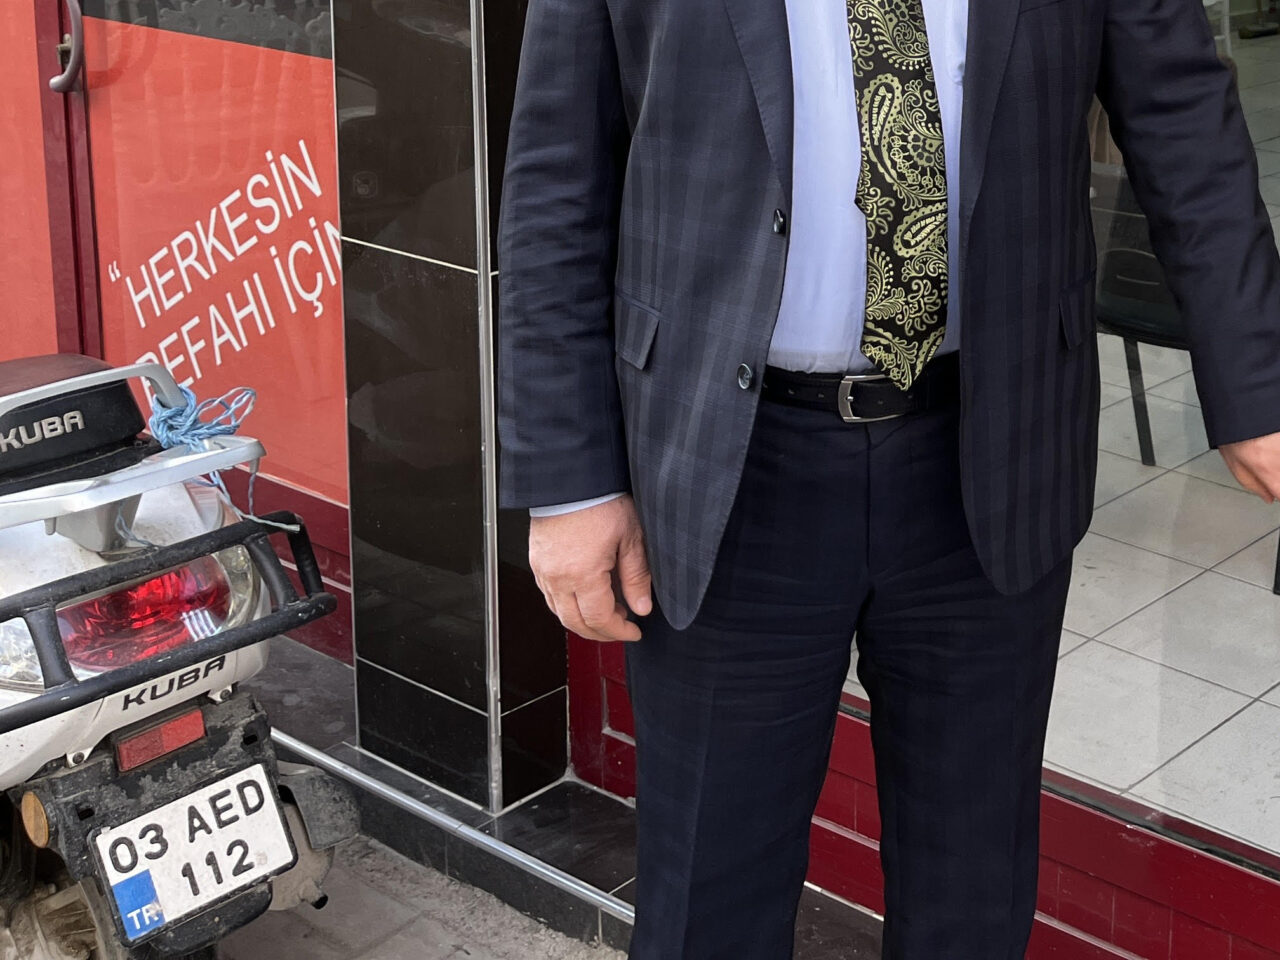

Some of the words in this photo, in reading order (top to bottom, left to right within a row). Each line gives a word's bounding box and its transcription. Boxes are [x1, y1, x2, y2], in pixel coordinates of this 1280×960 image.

[0, 410, 85, 452] KUBA
[121, 654, 226, 711] KUBA
[108, 823, 169, 874] 03
[187, 778, 265, 843] AED
[181, 839, 254, 897] 112
[127, 903, 161, 930] TR
